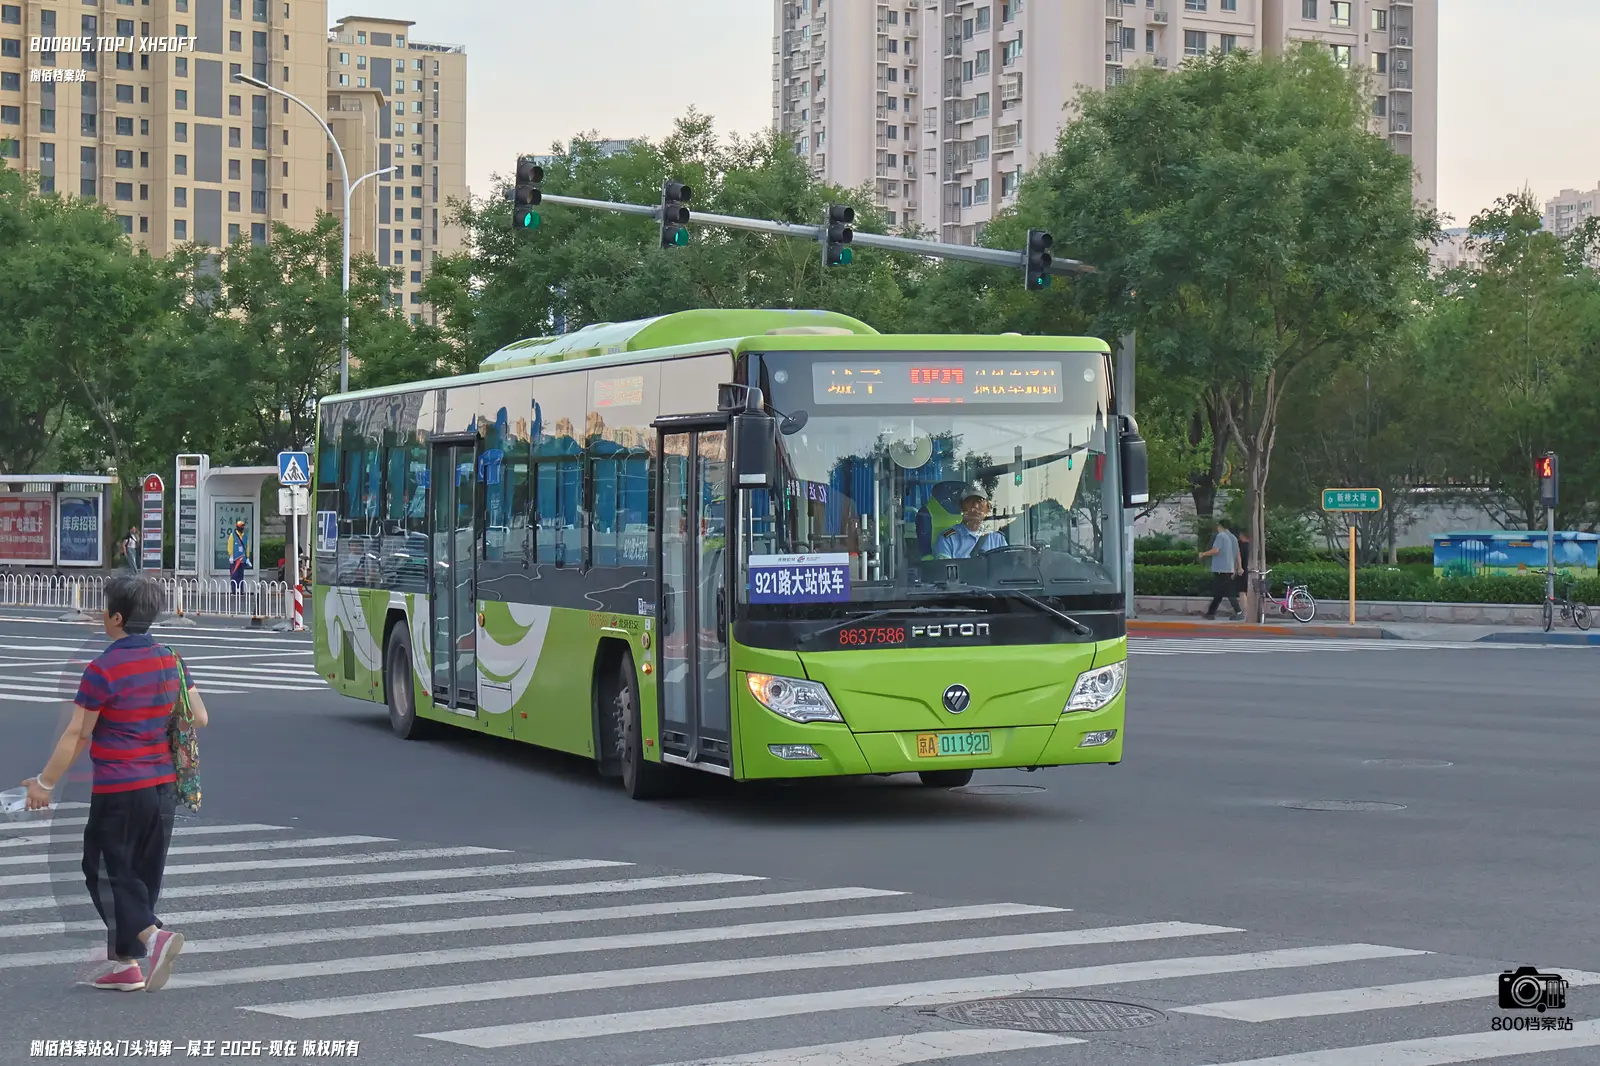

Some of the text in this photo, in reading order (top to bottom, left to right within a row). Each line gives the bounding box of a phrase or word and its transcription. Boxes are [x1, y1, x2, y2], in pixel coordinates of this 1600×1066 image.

[62, 516, 97, 531] 库房招租
[755, 567, 845, 596] 921路大站快车
[839, 627, 905, 644] 8637586
[911, 622, 990, 638] FOTON
